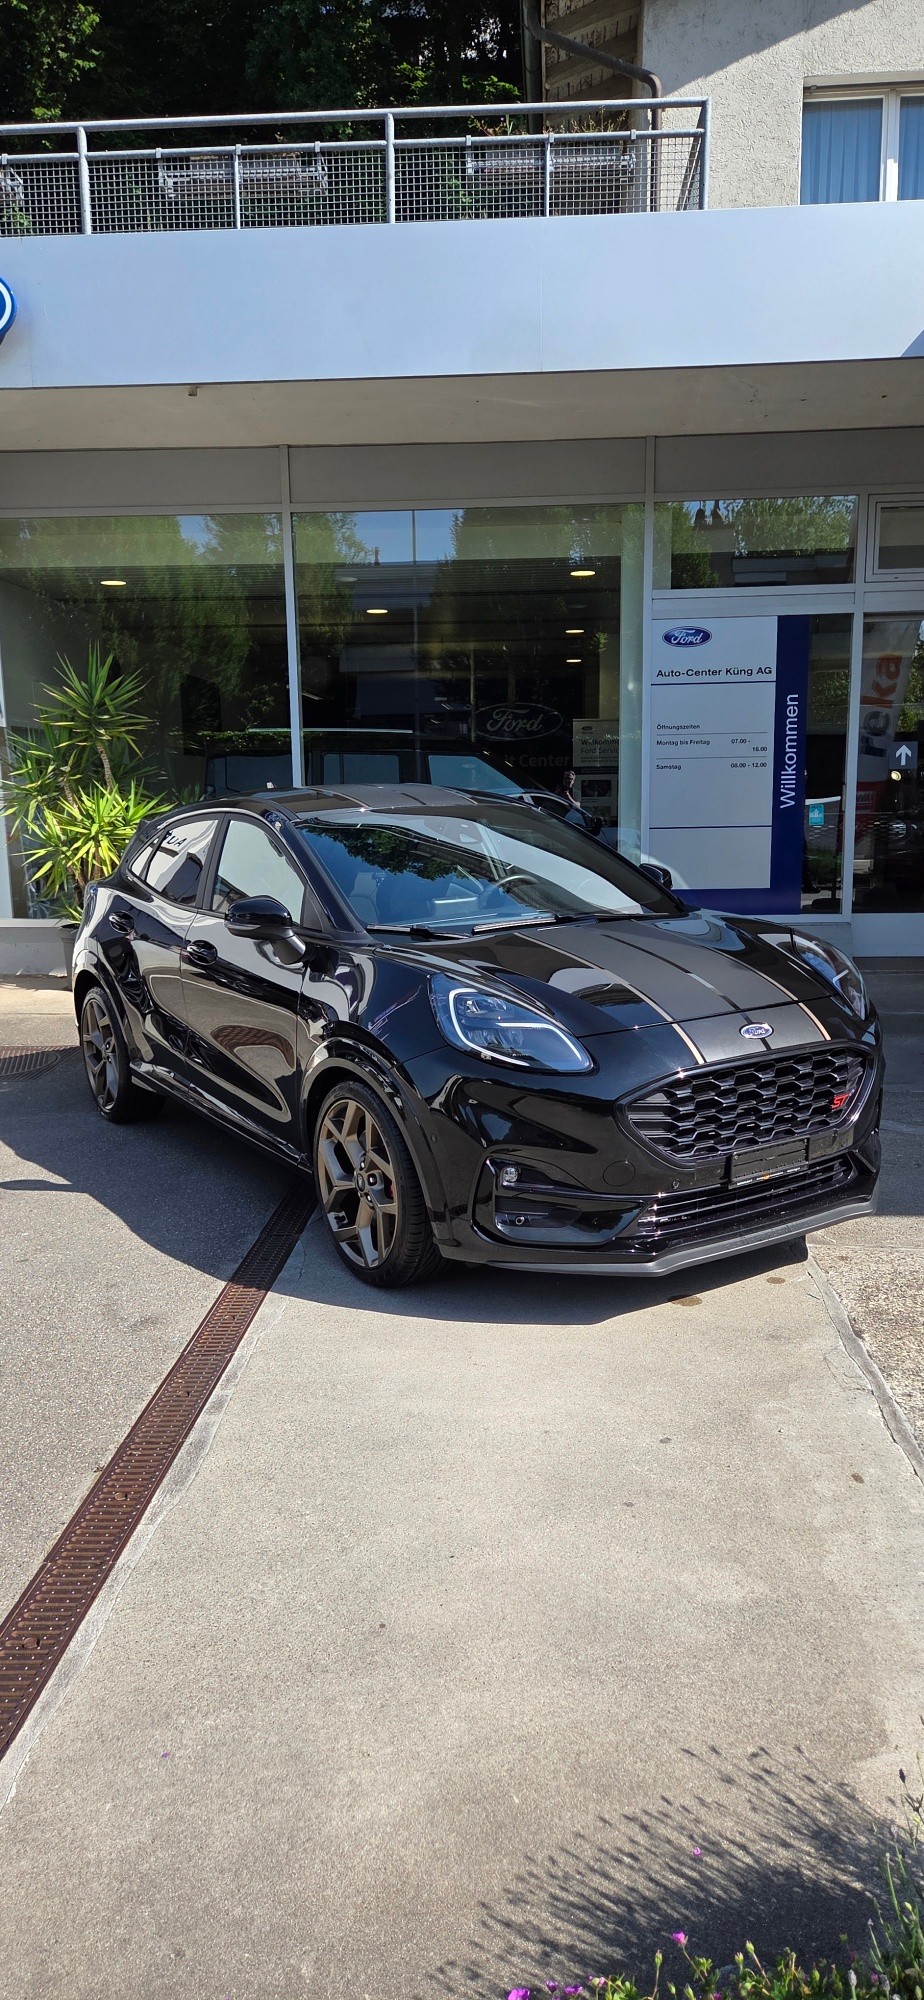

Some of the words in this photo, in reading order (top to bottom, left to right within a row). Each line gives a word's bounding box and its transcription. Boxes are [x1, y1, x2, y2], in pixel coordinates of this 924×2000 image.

[670, 629, 704, 644] Ford
[656, 668, 723, 678] Auto-Center
[725, 666, 753, 676] Küng
[756, 666, 773, 675] AG
[486, 707, 545, 732] Ford
[656, 723, 701, 731] Öffnungszeiten
[779, 694, 799, 809] Willkommen
[520, 754, 571, 768] Center
[830, 1093, 849, 1110] ST
